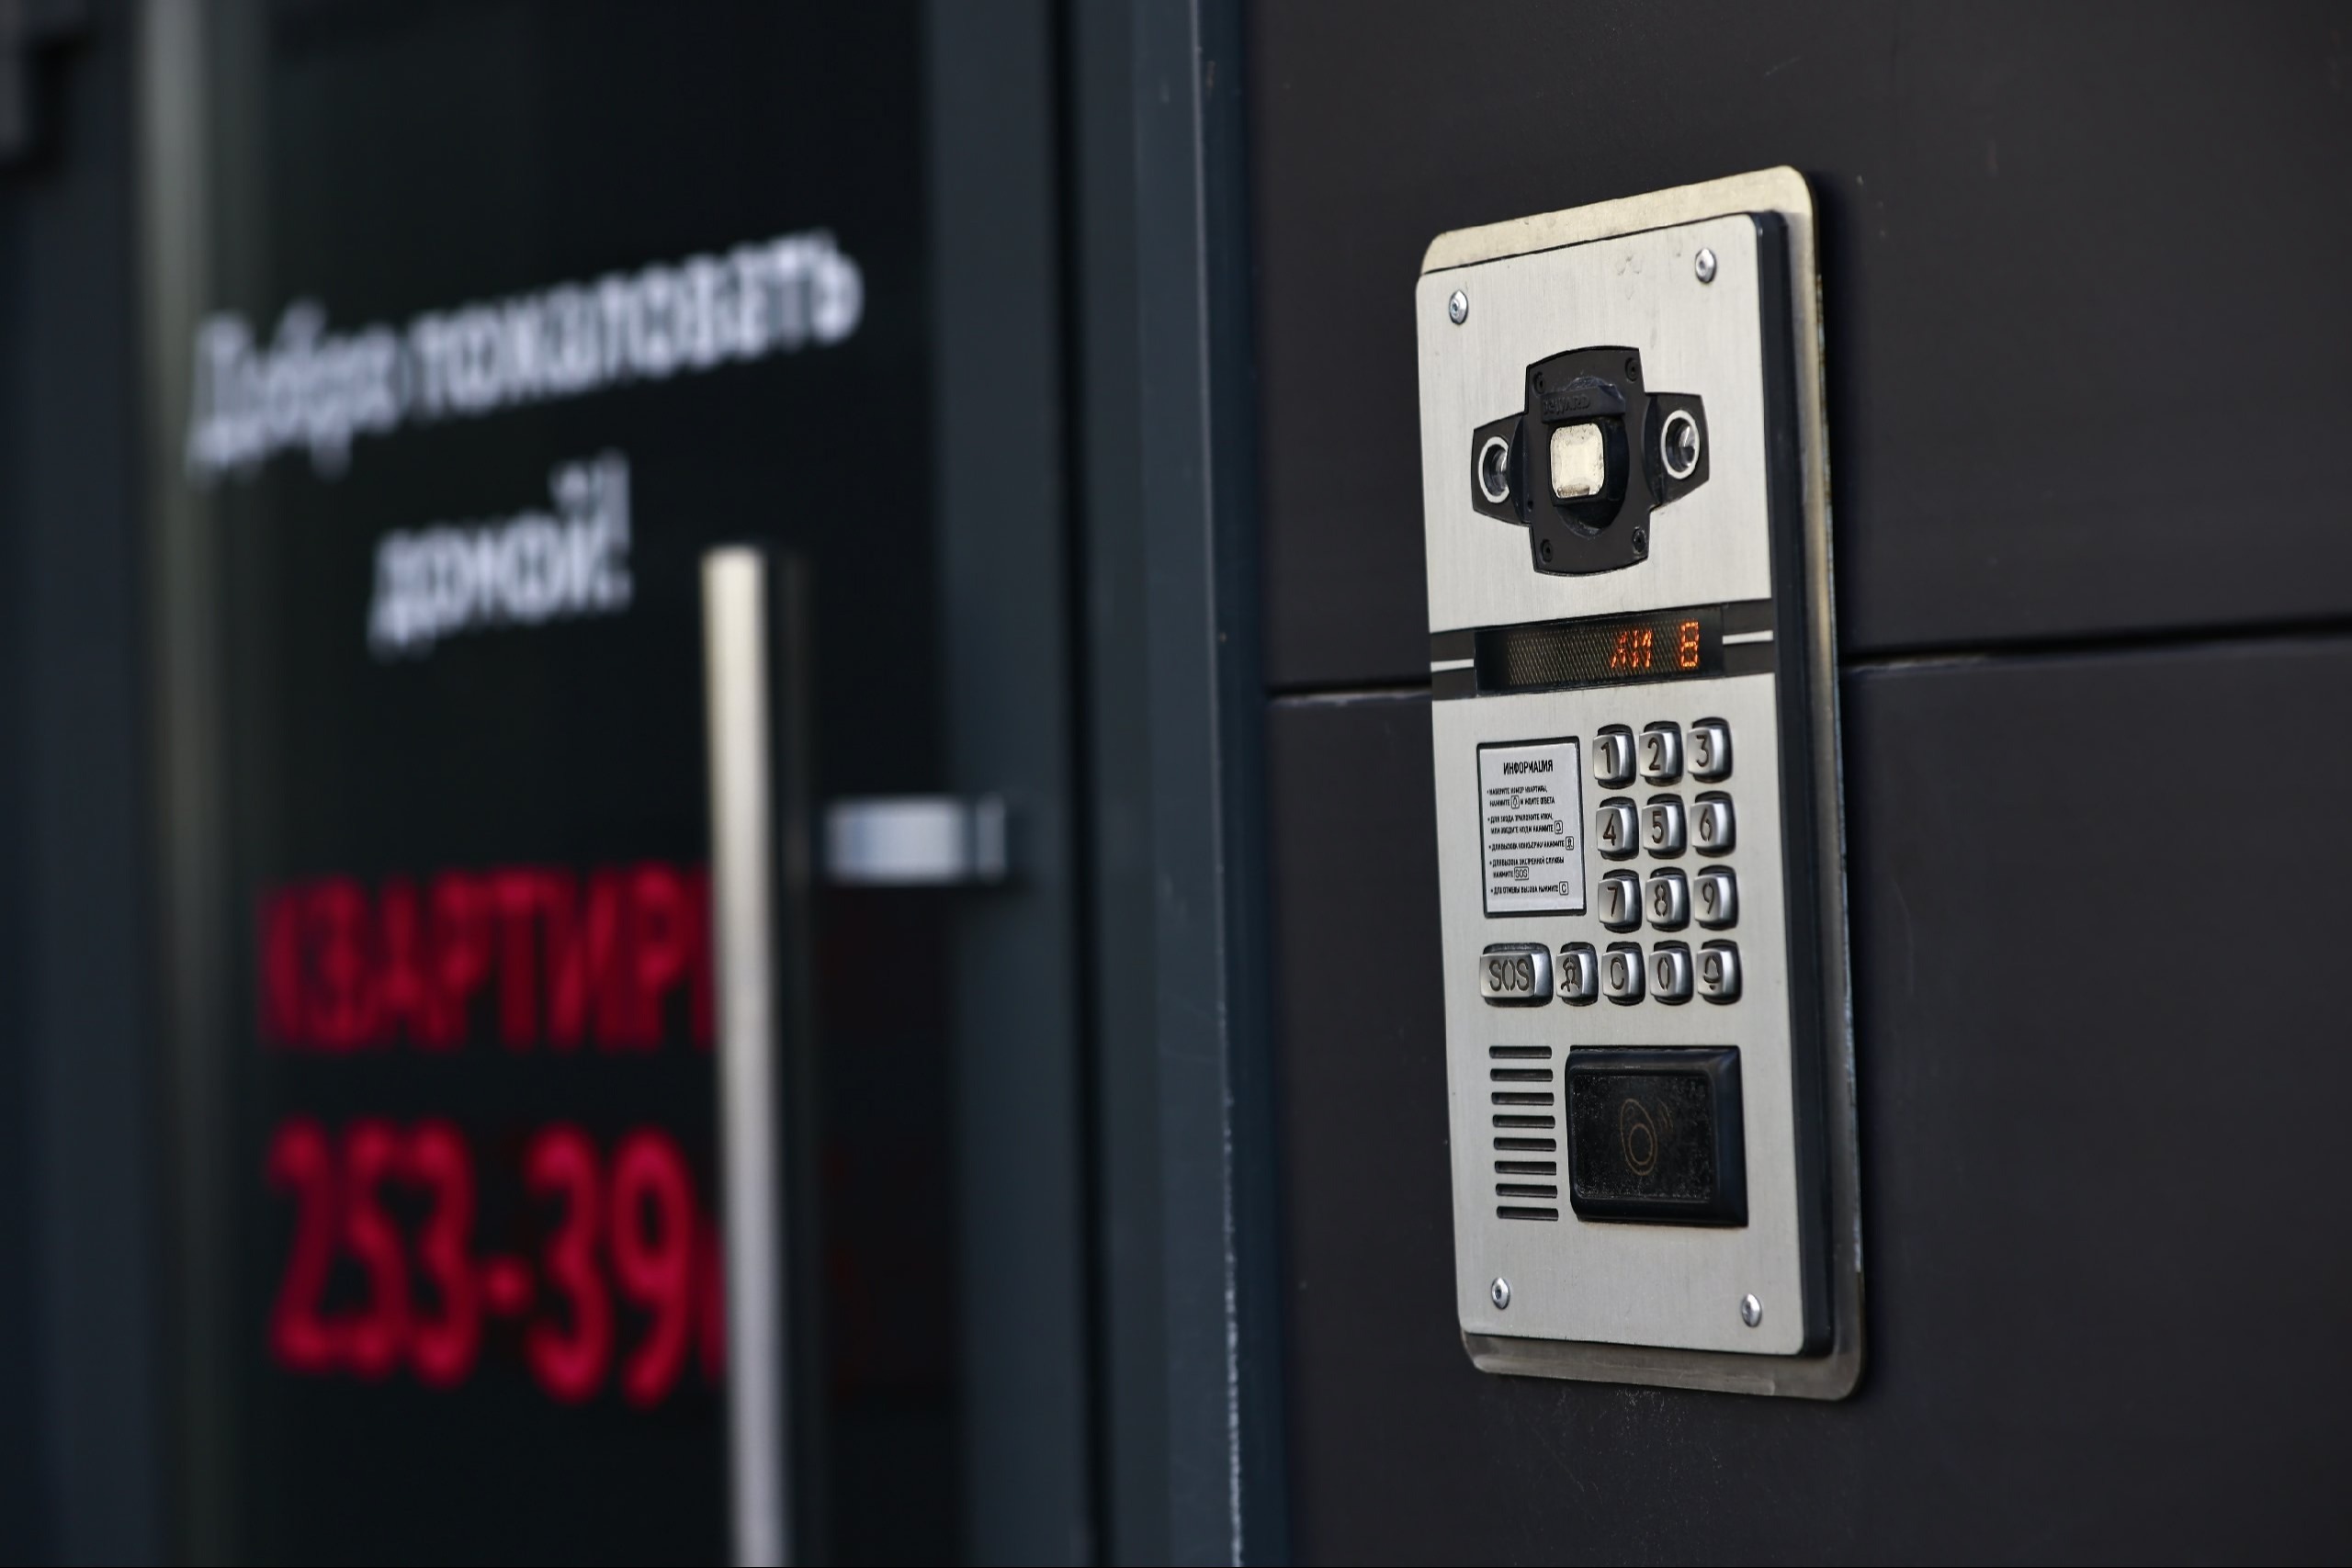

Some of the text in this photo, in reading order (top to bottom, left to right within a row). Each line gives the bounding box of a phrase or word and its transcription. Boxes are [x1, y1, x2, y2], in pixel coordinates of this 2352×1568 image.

[1503, 759, 1553, 775] ИНФОРМАЦИЯ
[1600, 735, 1710, 774] 1 2 3
[1602, 807, 1713, 846] 4 5 6
[1515, 869, 1528, 878] SOS
[1607, 881, 1715, 918] 7 8 9
[259, 862, 719, 1054] КВАРТИР
[1488, 956, 1669, 992] SOS C 0
[271, 1115, 725, 1407] 253-39
